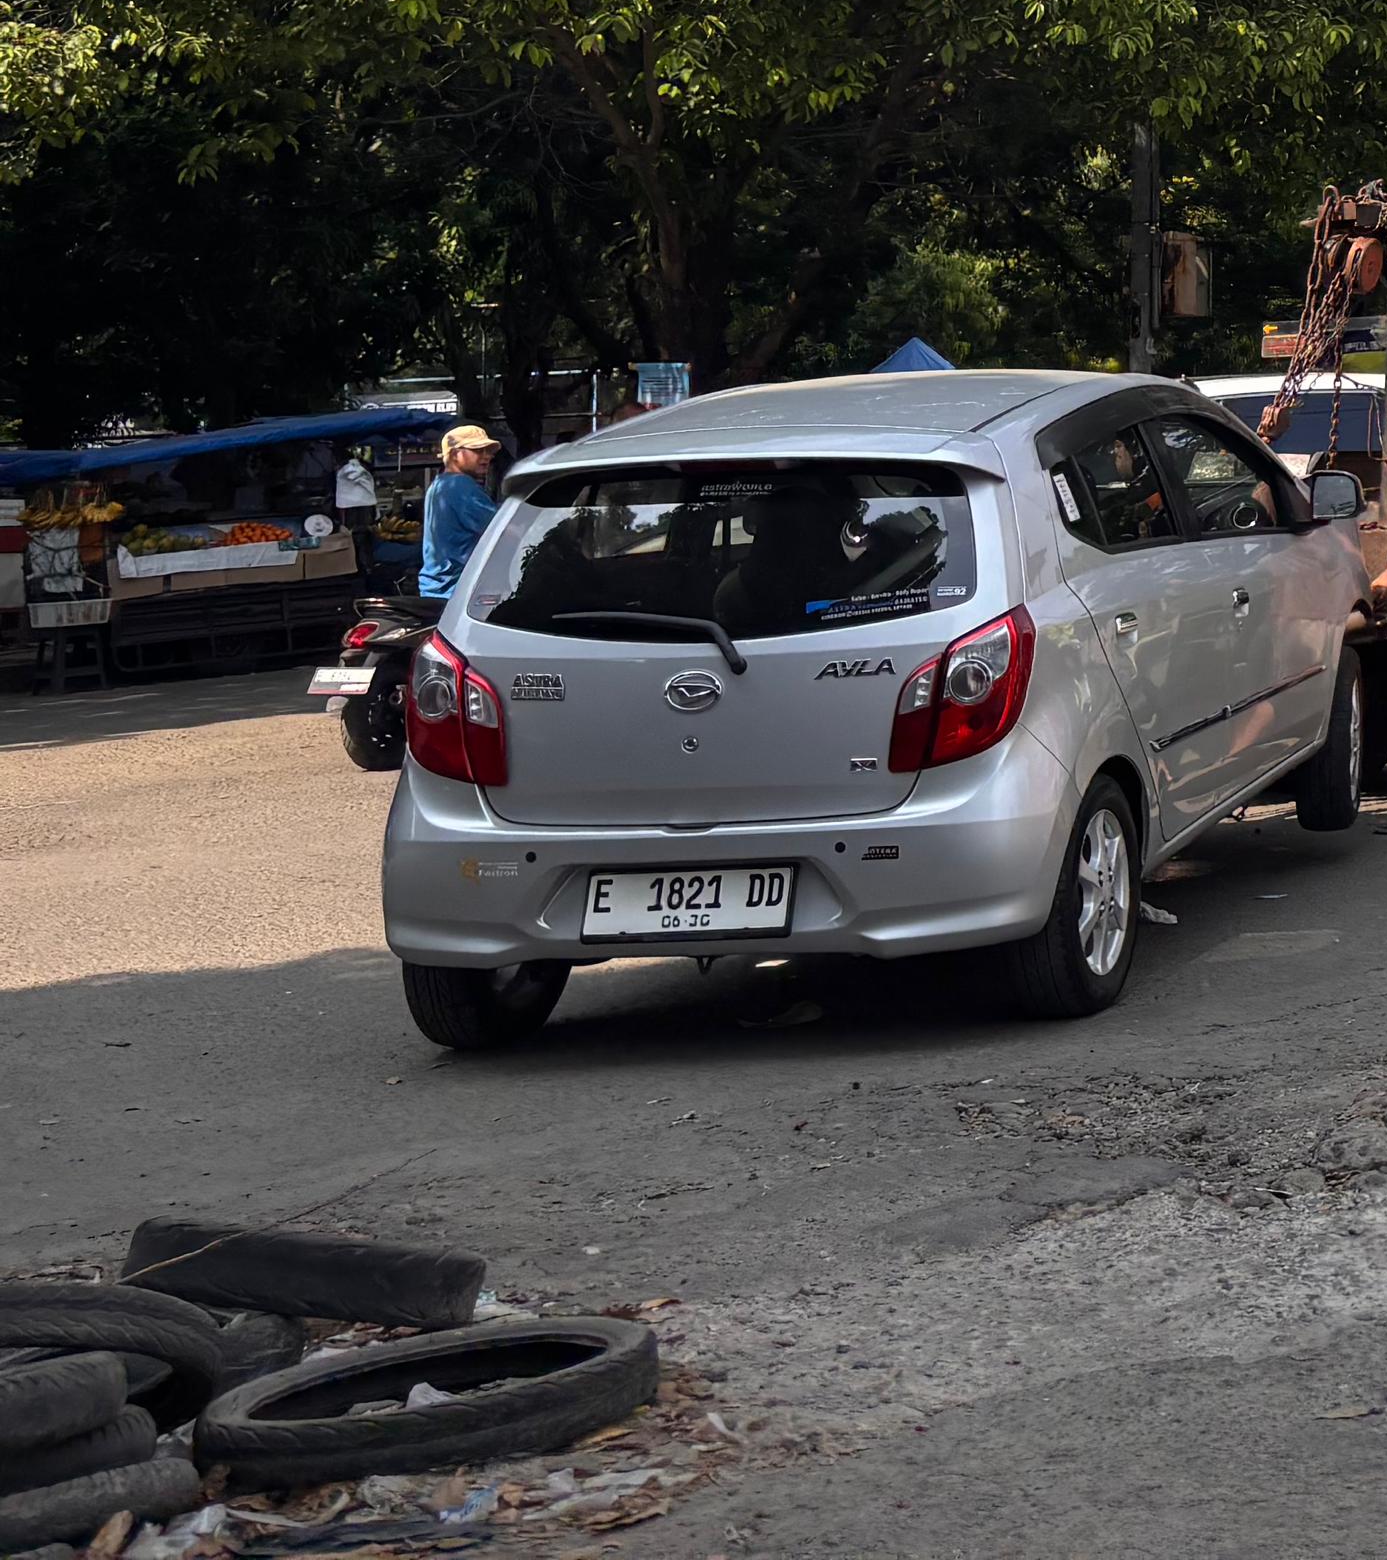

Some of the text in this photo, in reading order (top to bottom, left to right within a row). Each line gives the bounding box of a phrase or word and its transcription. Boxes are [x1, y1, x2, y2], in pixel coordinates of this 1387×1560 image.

[512, 672, 563, 688] ASTRA
[813, 656, 897, 680] AYLA
[592, 872, 785, 913] E 1821 DD
